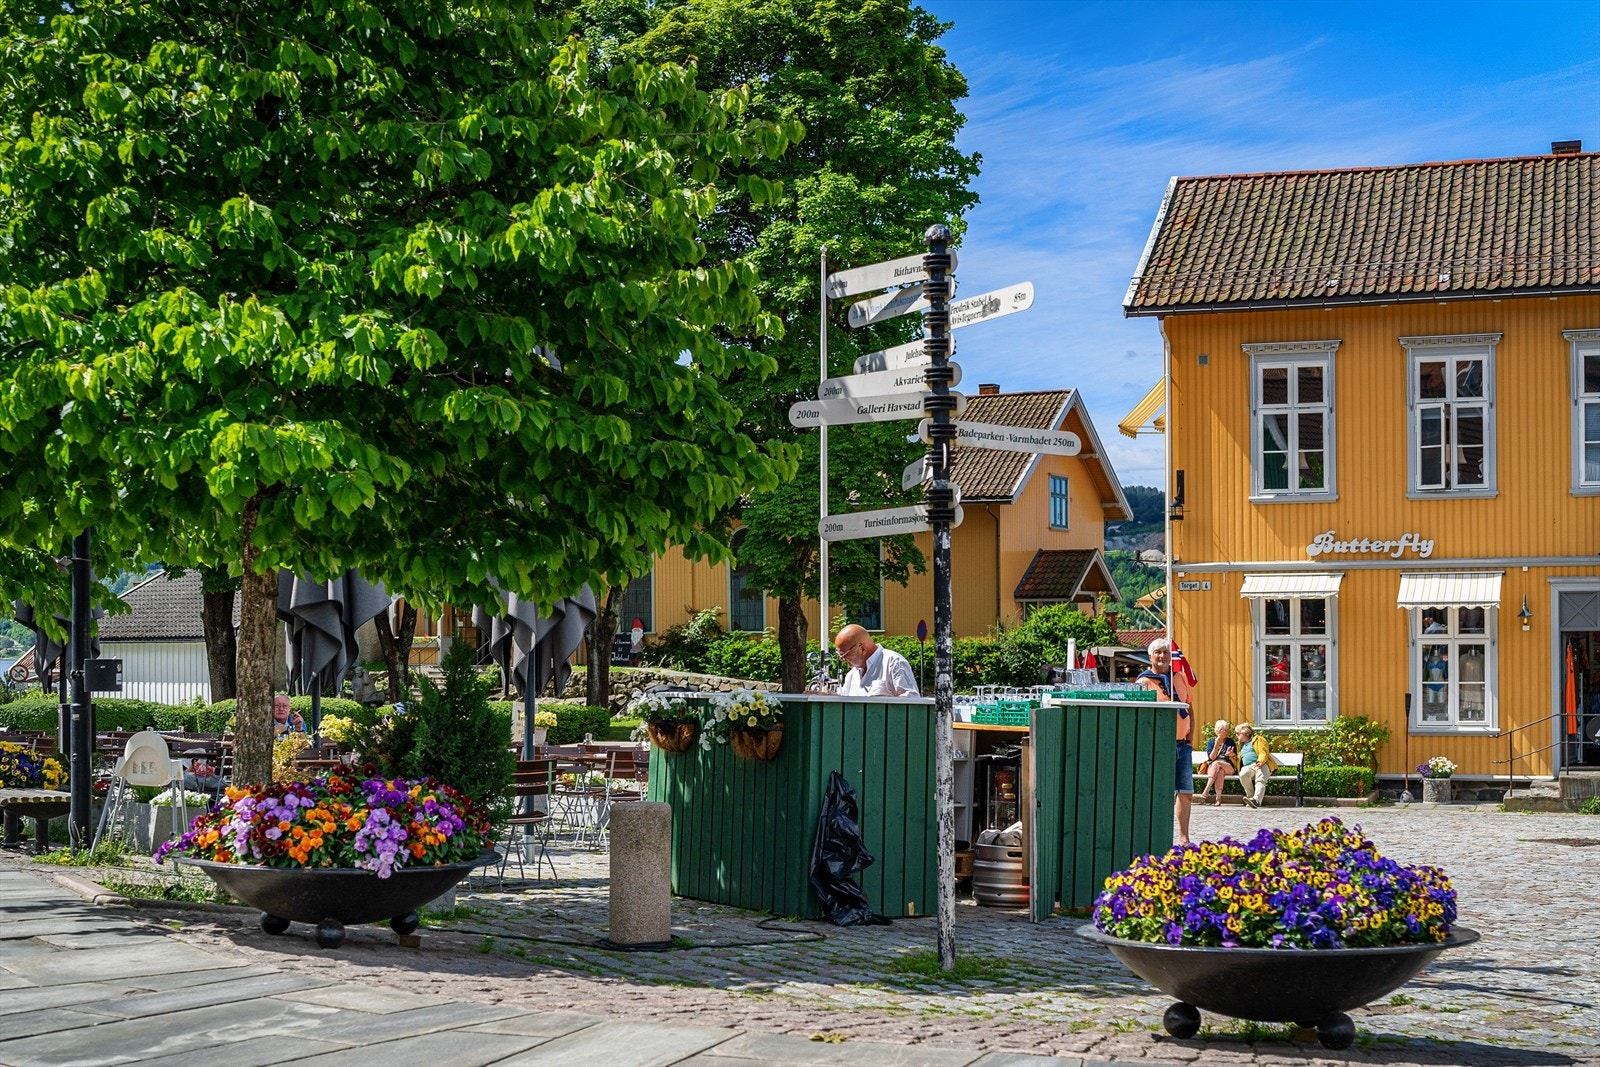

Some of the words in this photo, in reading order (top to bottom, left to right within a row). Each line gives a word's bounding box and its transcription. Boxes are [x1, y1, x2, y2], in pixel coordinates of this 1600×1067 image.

[823, 386, 843, 397] 200m
[796, 409, 820, 419] 200m
[857, 404, 886, 415] Galleri
[887, 400, 921, 413] Havstad
[958, 428, 1005, 442] Badeparken
[1053, 437, 1075, 448] 250m
[824, 522, 844, 533] 200m
[864, 513, 926, 529] Turistinformasjon
[1305, 530, 1435, 559] Butterfly
[1181, 582, 1198, 590] Torget
